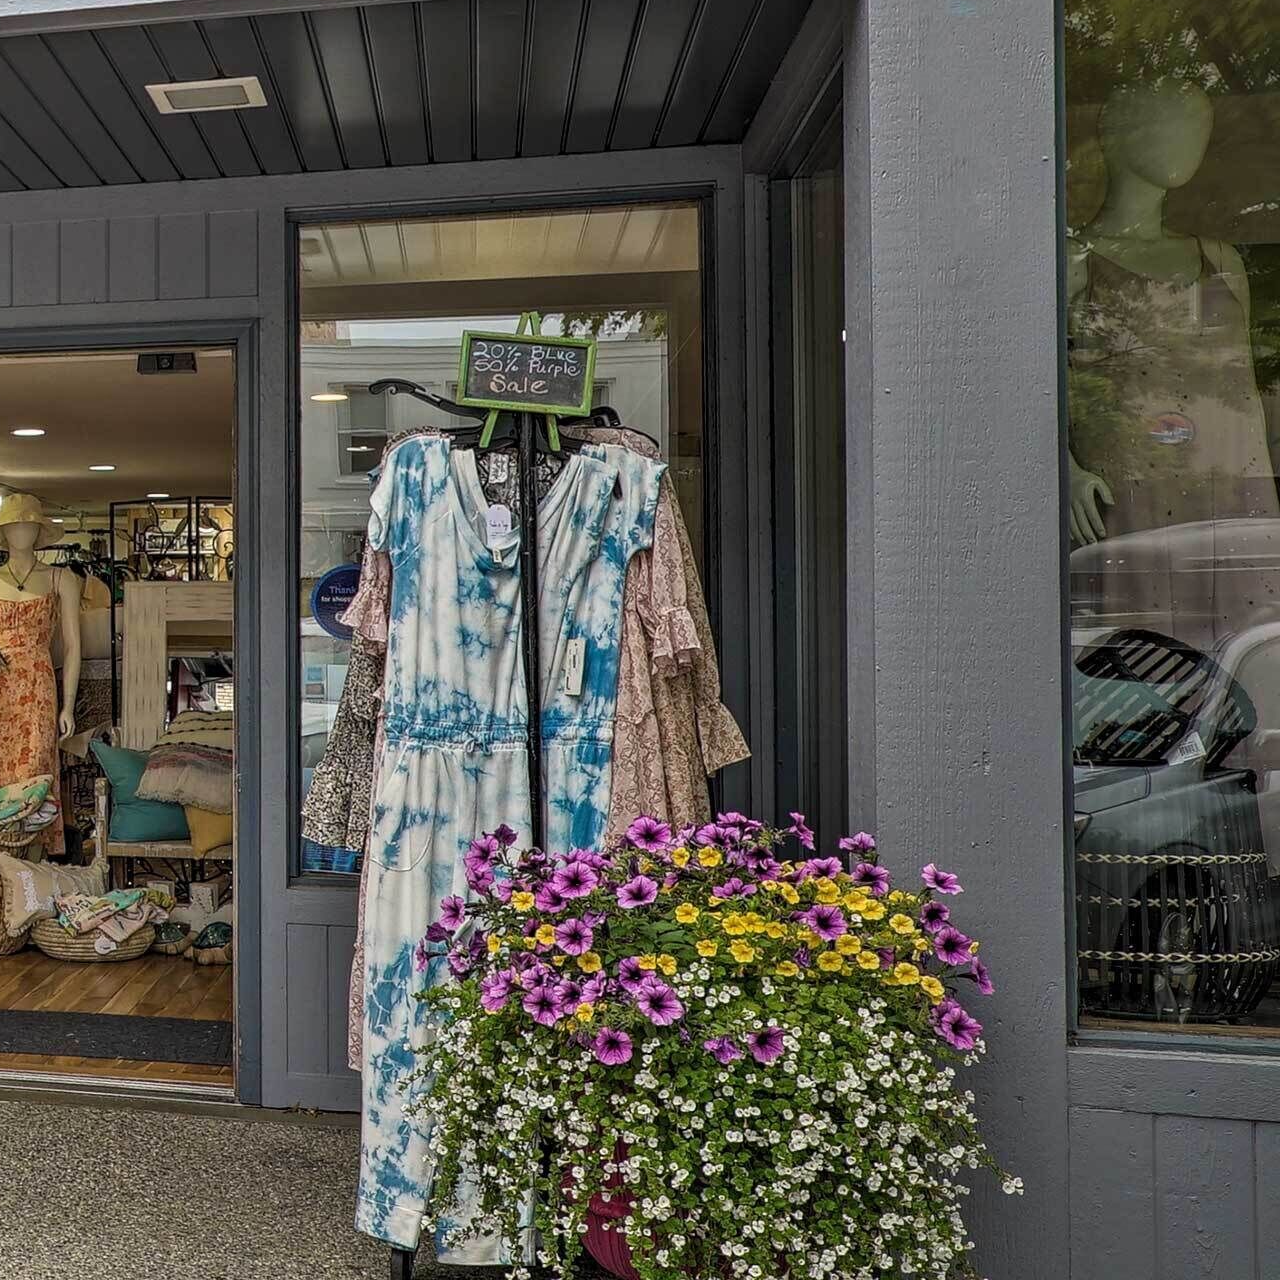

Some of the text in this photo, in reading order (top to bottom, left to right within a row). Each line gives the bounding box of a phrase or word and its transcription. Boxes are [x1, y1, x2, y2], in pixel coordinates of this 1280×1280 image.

[472, 341, 521, 359] 20%
[473, 358, 581, 377] 50% Purple
[490, 373, 549, 394] Sale
